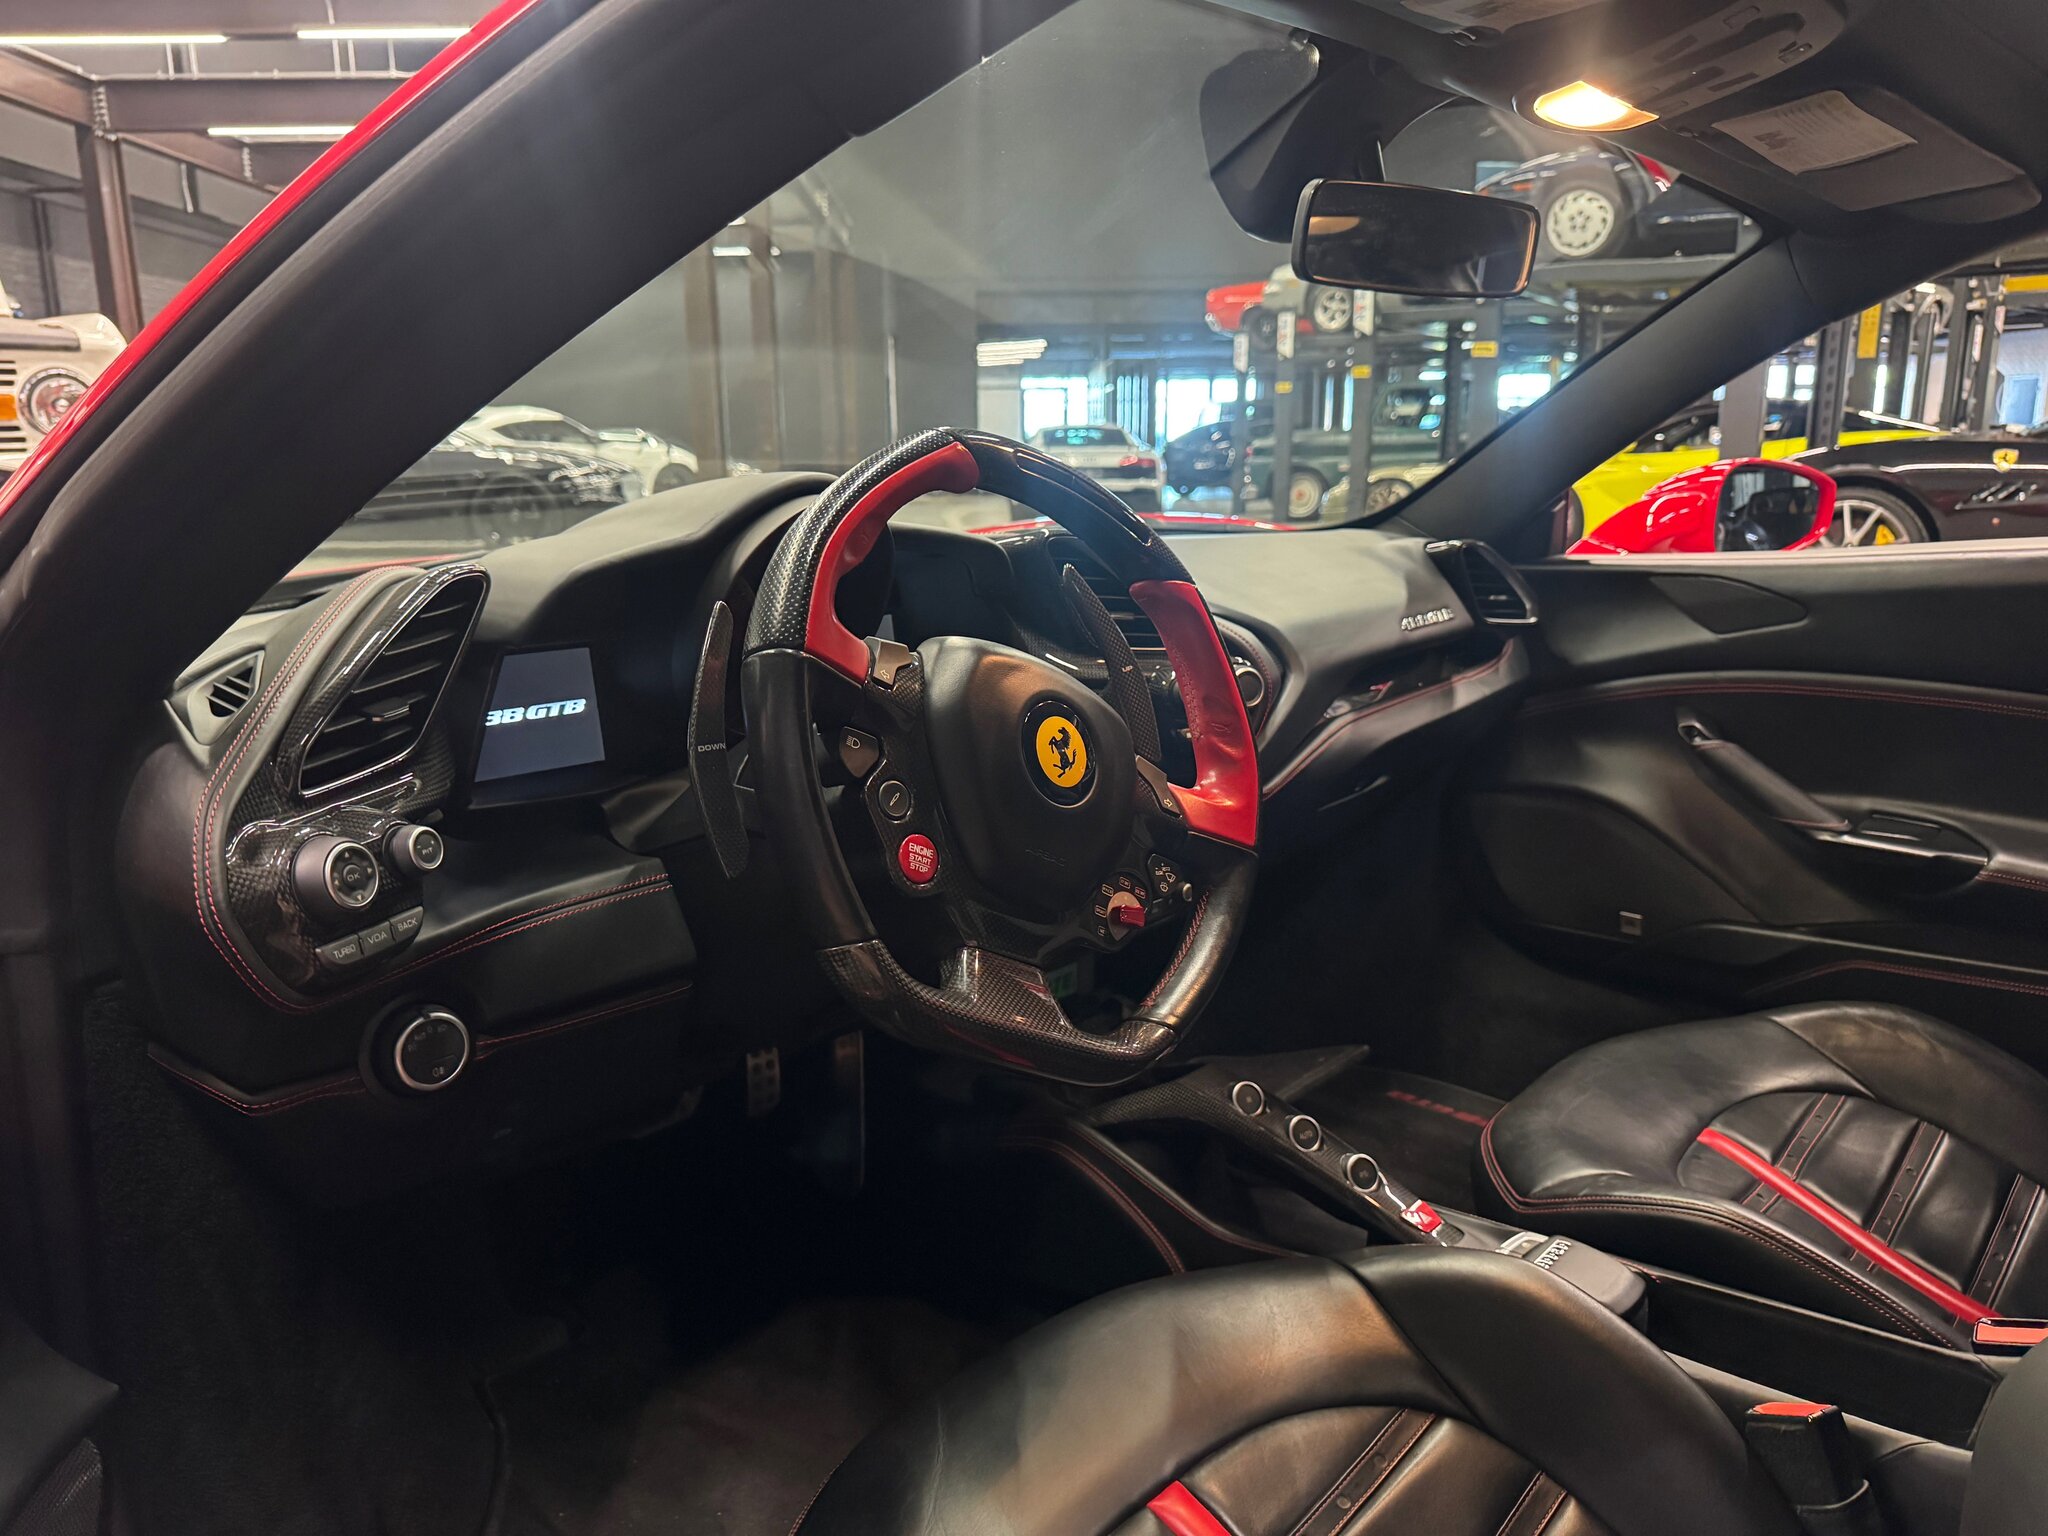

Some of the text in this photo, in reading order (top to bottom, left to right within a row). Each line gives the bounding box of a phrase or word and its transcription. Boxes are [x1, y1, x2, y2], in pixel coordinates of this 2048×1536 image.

[525, 698, 587, 720] GTB
[697, 742, 727, 752] DOWN
[909, 843, 933, 858] ENGINE
[909, 853, 931, 865] START
[910, 863, 928, 872] STOP
[347, 872, 360, 882] OK
[398, 918, 418, 931] BACK
[333, 944, 356, 959] TURBO
